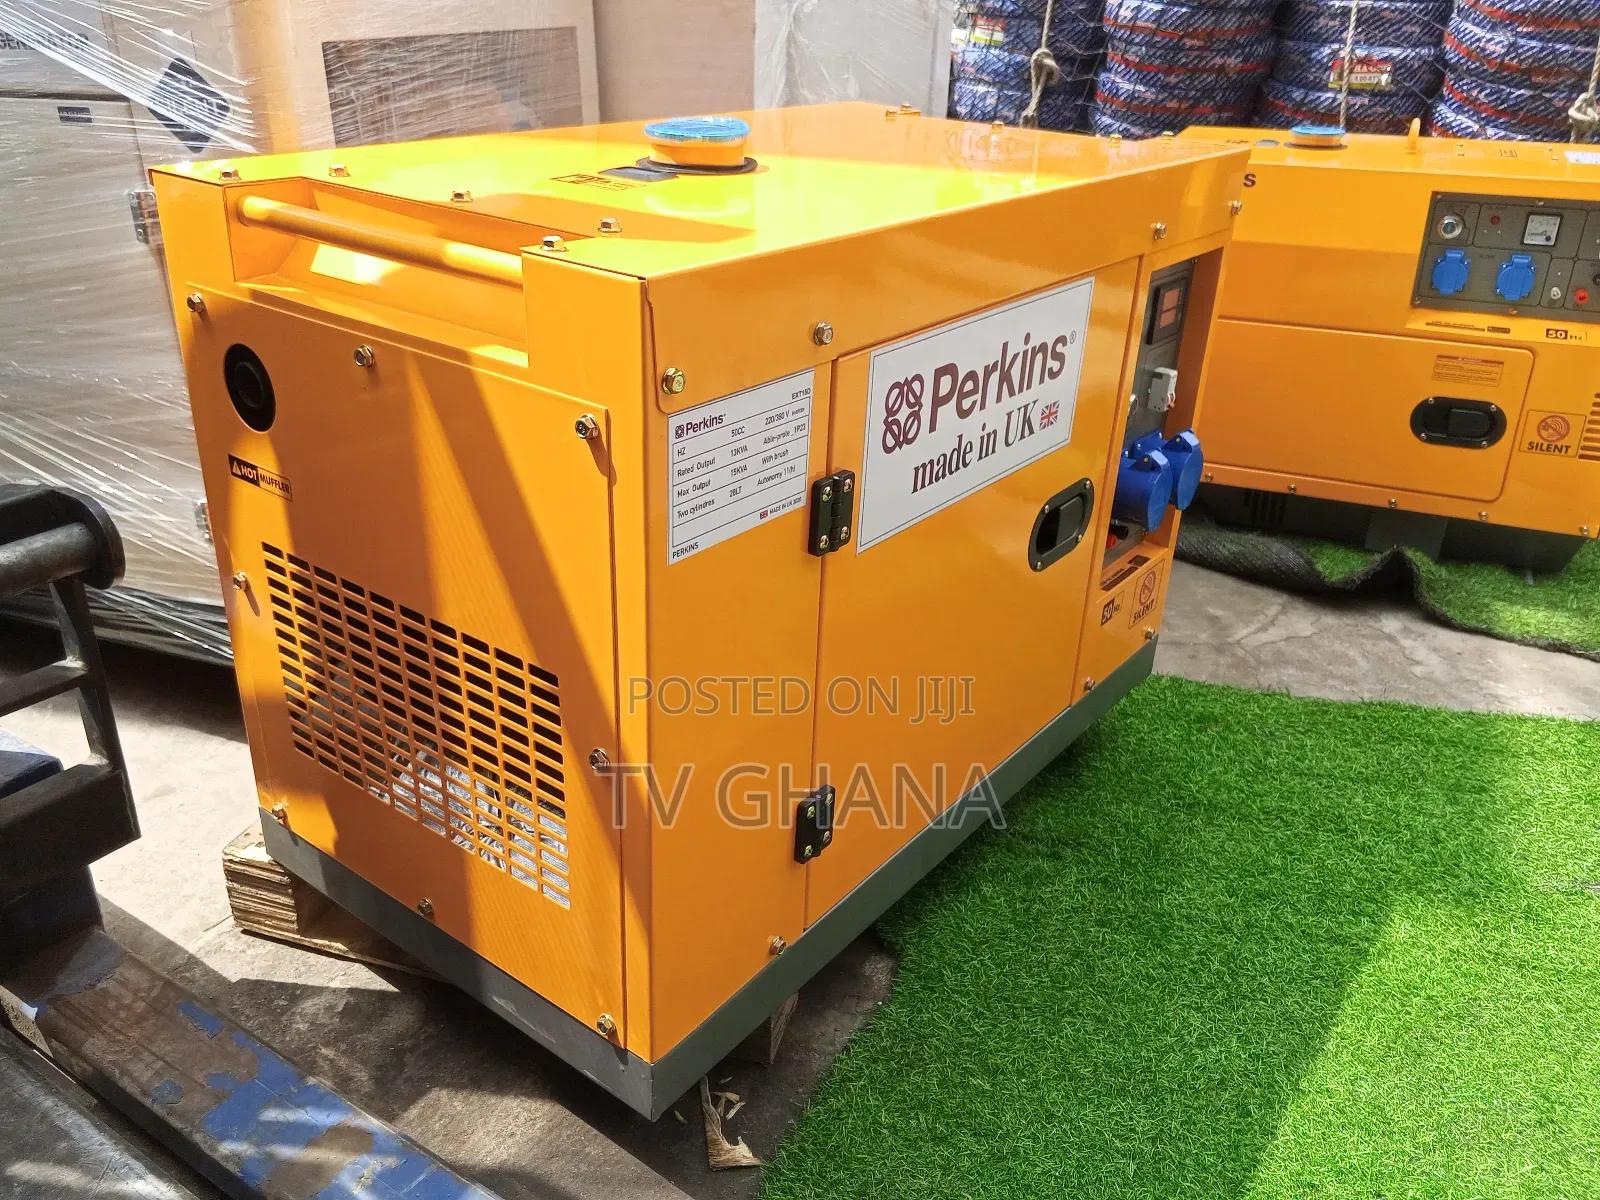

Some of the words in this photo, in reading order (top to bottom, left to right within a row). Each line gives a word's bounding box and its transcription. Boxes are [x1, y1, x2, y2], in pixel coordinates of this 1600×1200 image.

[1547, 329, 1566, 339] 50
[765, 411, 785, 426] 220/380
[677, 446, 686, 457] HZ
[911, 433, 974, 494] made
[977, 422, 998, 463] in
[1004, 398, 1039, 448] UK
[1527, 441, 1571, 455] SILENT
[761, 453, 774, 465] With
[774, 448, 789, 460] brush
[677, 463, 694, 478] Rated
[696, 457, 716, 470] Output
[240, 464, 257, 481] HOT
[260, 472, 291, 495] MUFFLER
[677, 488, 690, 499] Max
[692, 478, 711, 492] Output
[757, 472, 783, 487] Autonomy
[677, 509, 689, 519] Two
[690, 498, 715, 515] cylindres
[769, 504, 781, 515] MADE
[781, 502, 787, 510] IN
[672, 541, 699, 560] PERKINS
[1101, 602, 1113, 624] 50
[1132, 598, 1155, 624] SILENT
